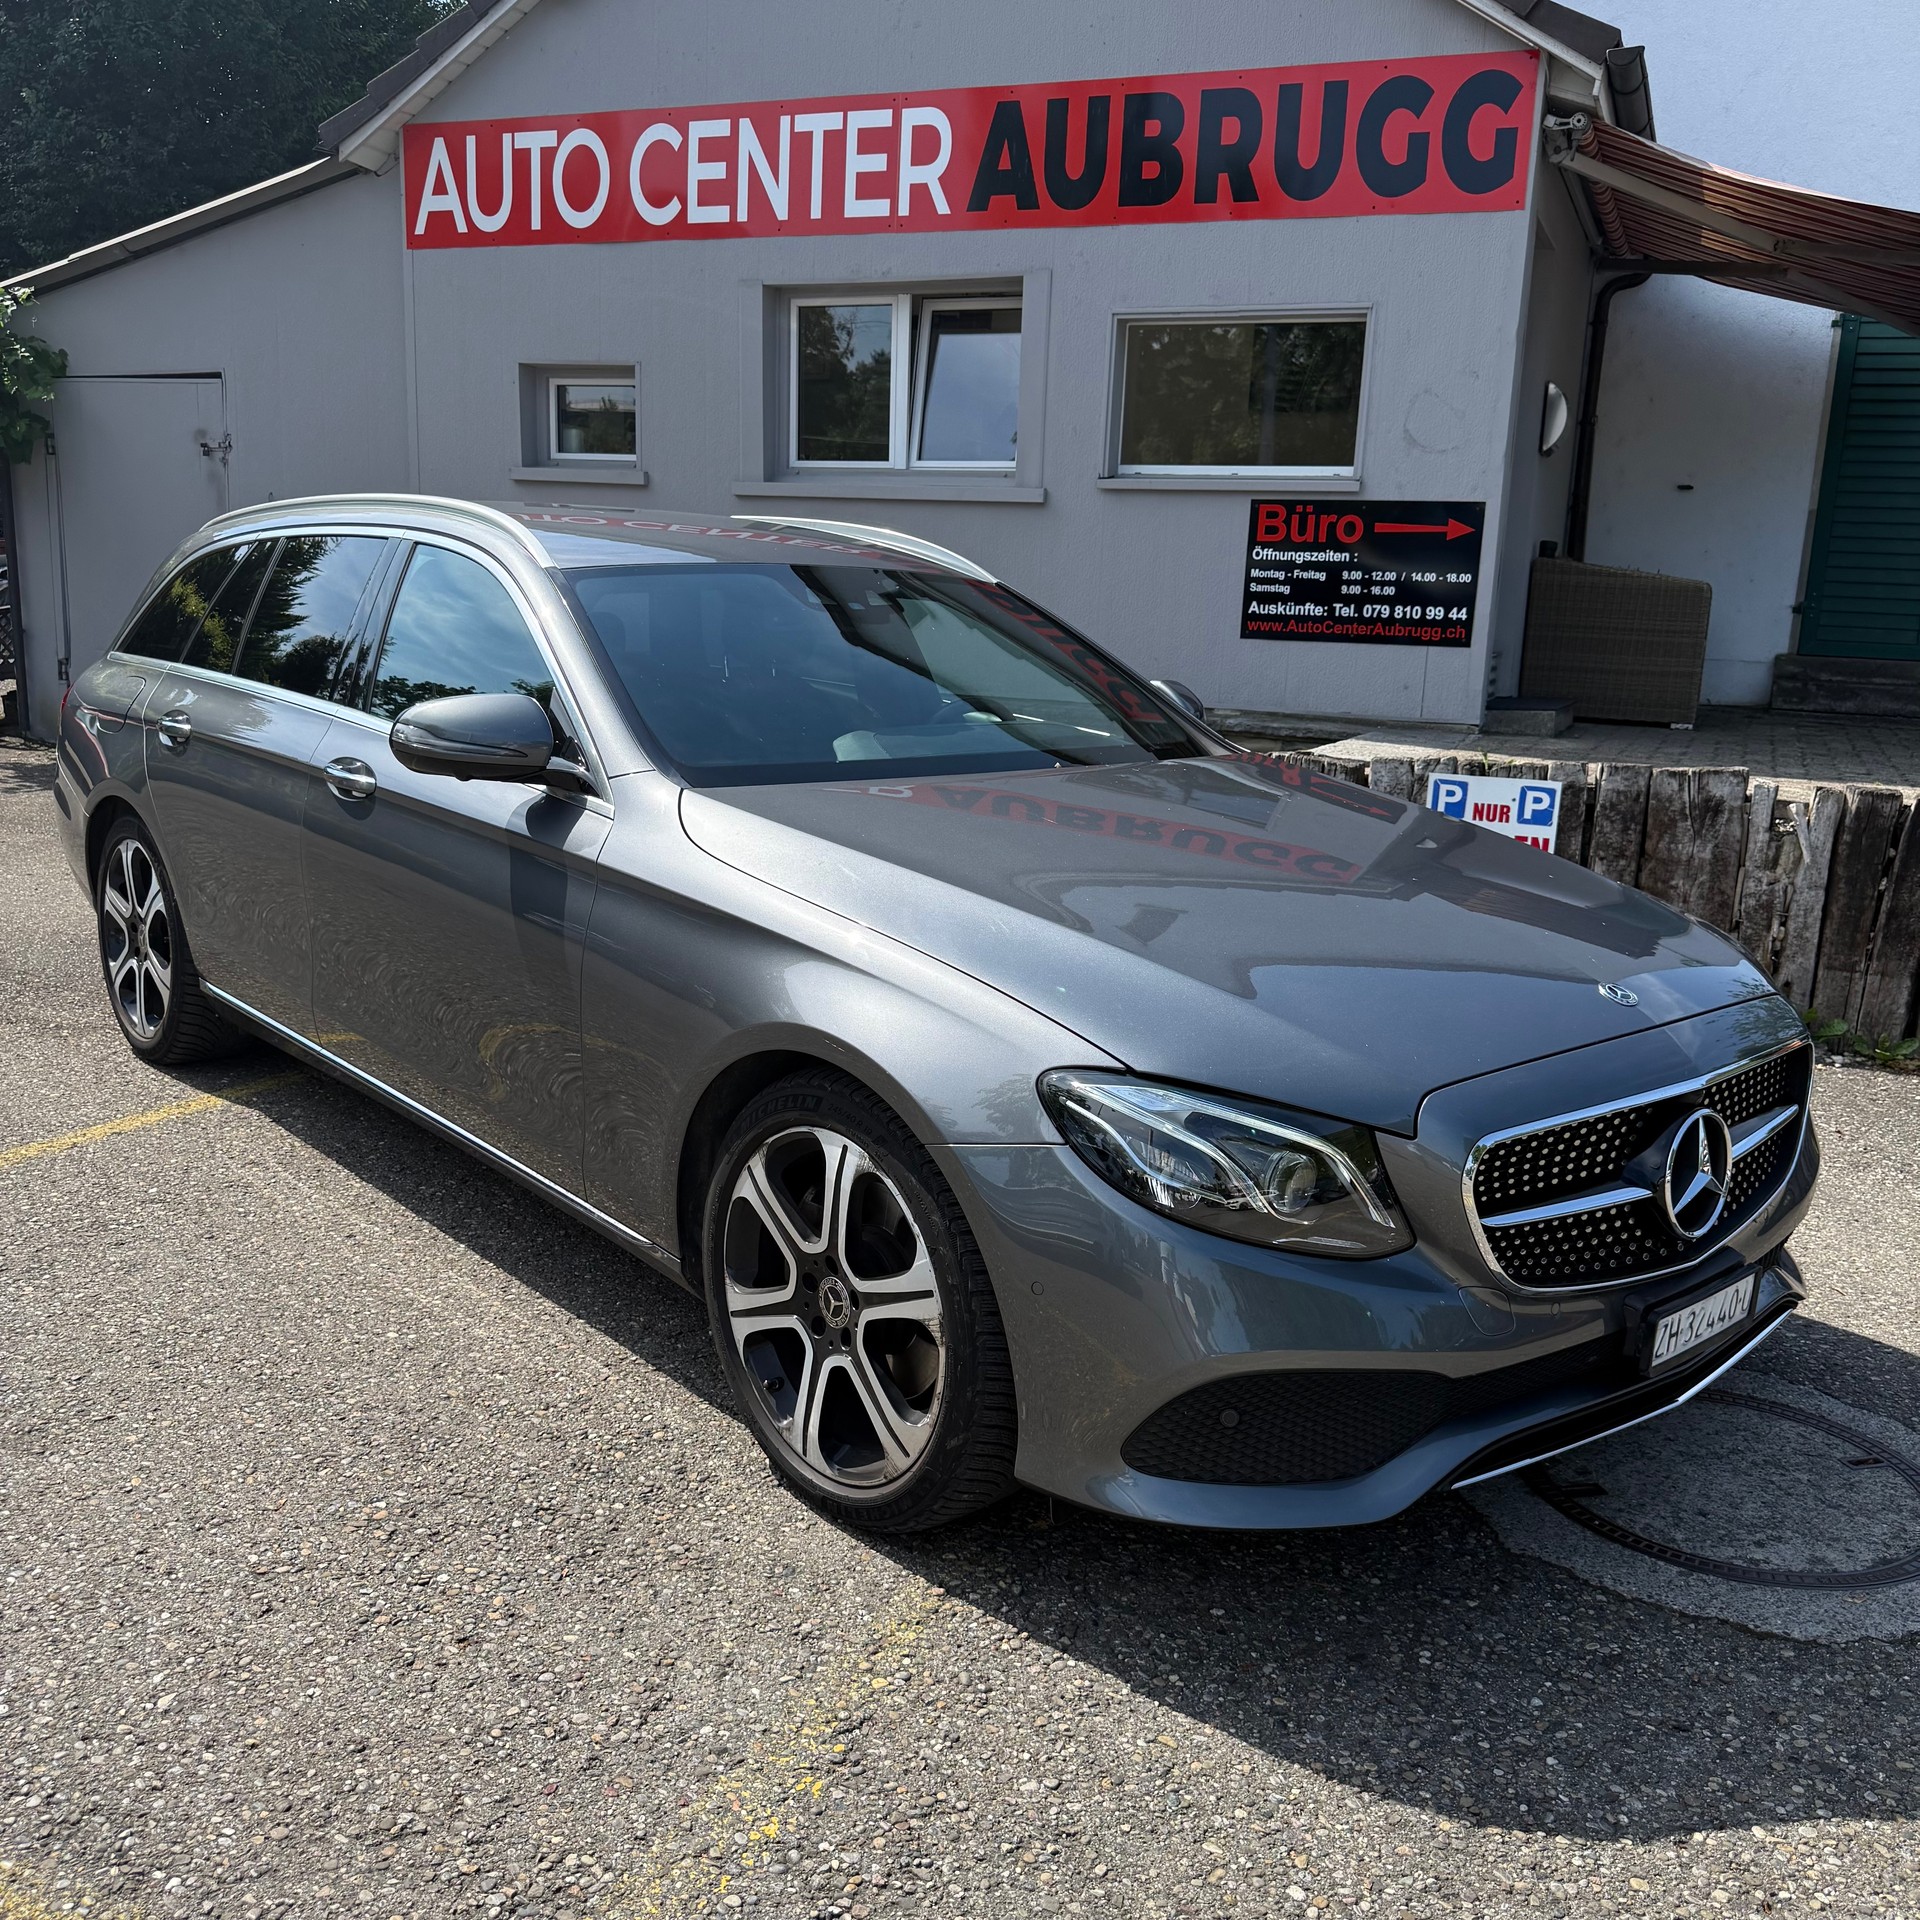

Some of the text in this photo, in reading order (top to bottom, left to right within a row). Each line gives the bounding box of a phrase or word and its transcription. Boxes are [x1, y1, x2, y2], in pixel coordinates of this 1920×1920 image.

[414, 69, 1525, 236] AUTO CENTER AUBRUGG
[1256, 504, 1364, 544] Büro
[1252, 546, 1350, 564] Öffnungszeiten
[1250, 568, 1286, 580] Montag
[1293, 569, 1327, 582] Freitag
[1341, 570, 1363, 581] 9.00
[1371, 571, 1397, 582] 12.00
[1410, 572, 1436, 583] 14.00
[1446, 573, 1472, 583] 18.00
[1249, 582, 1291, 595] Samstag
[1340, 585, 1362, 595] 9.00
[1369, 585, 1396, 596] 16.00
[1248, 601, 1468, 621] Auskünfte: Tel. 079 810 99 44
[1247, 619, 1467, 641] www.AutoCenterAubrugg.ch
[1471, 802, 1511, 824] NUR
